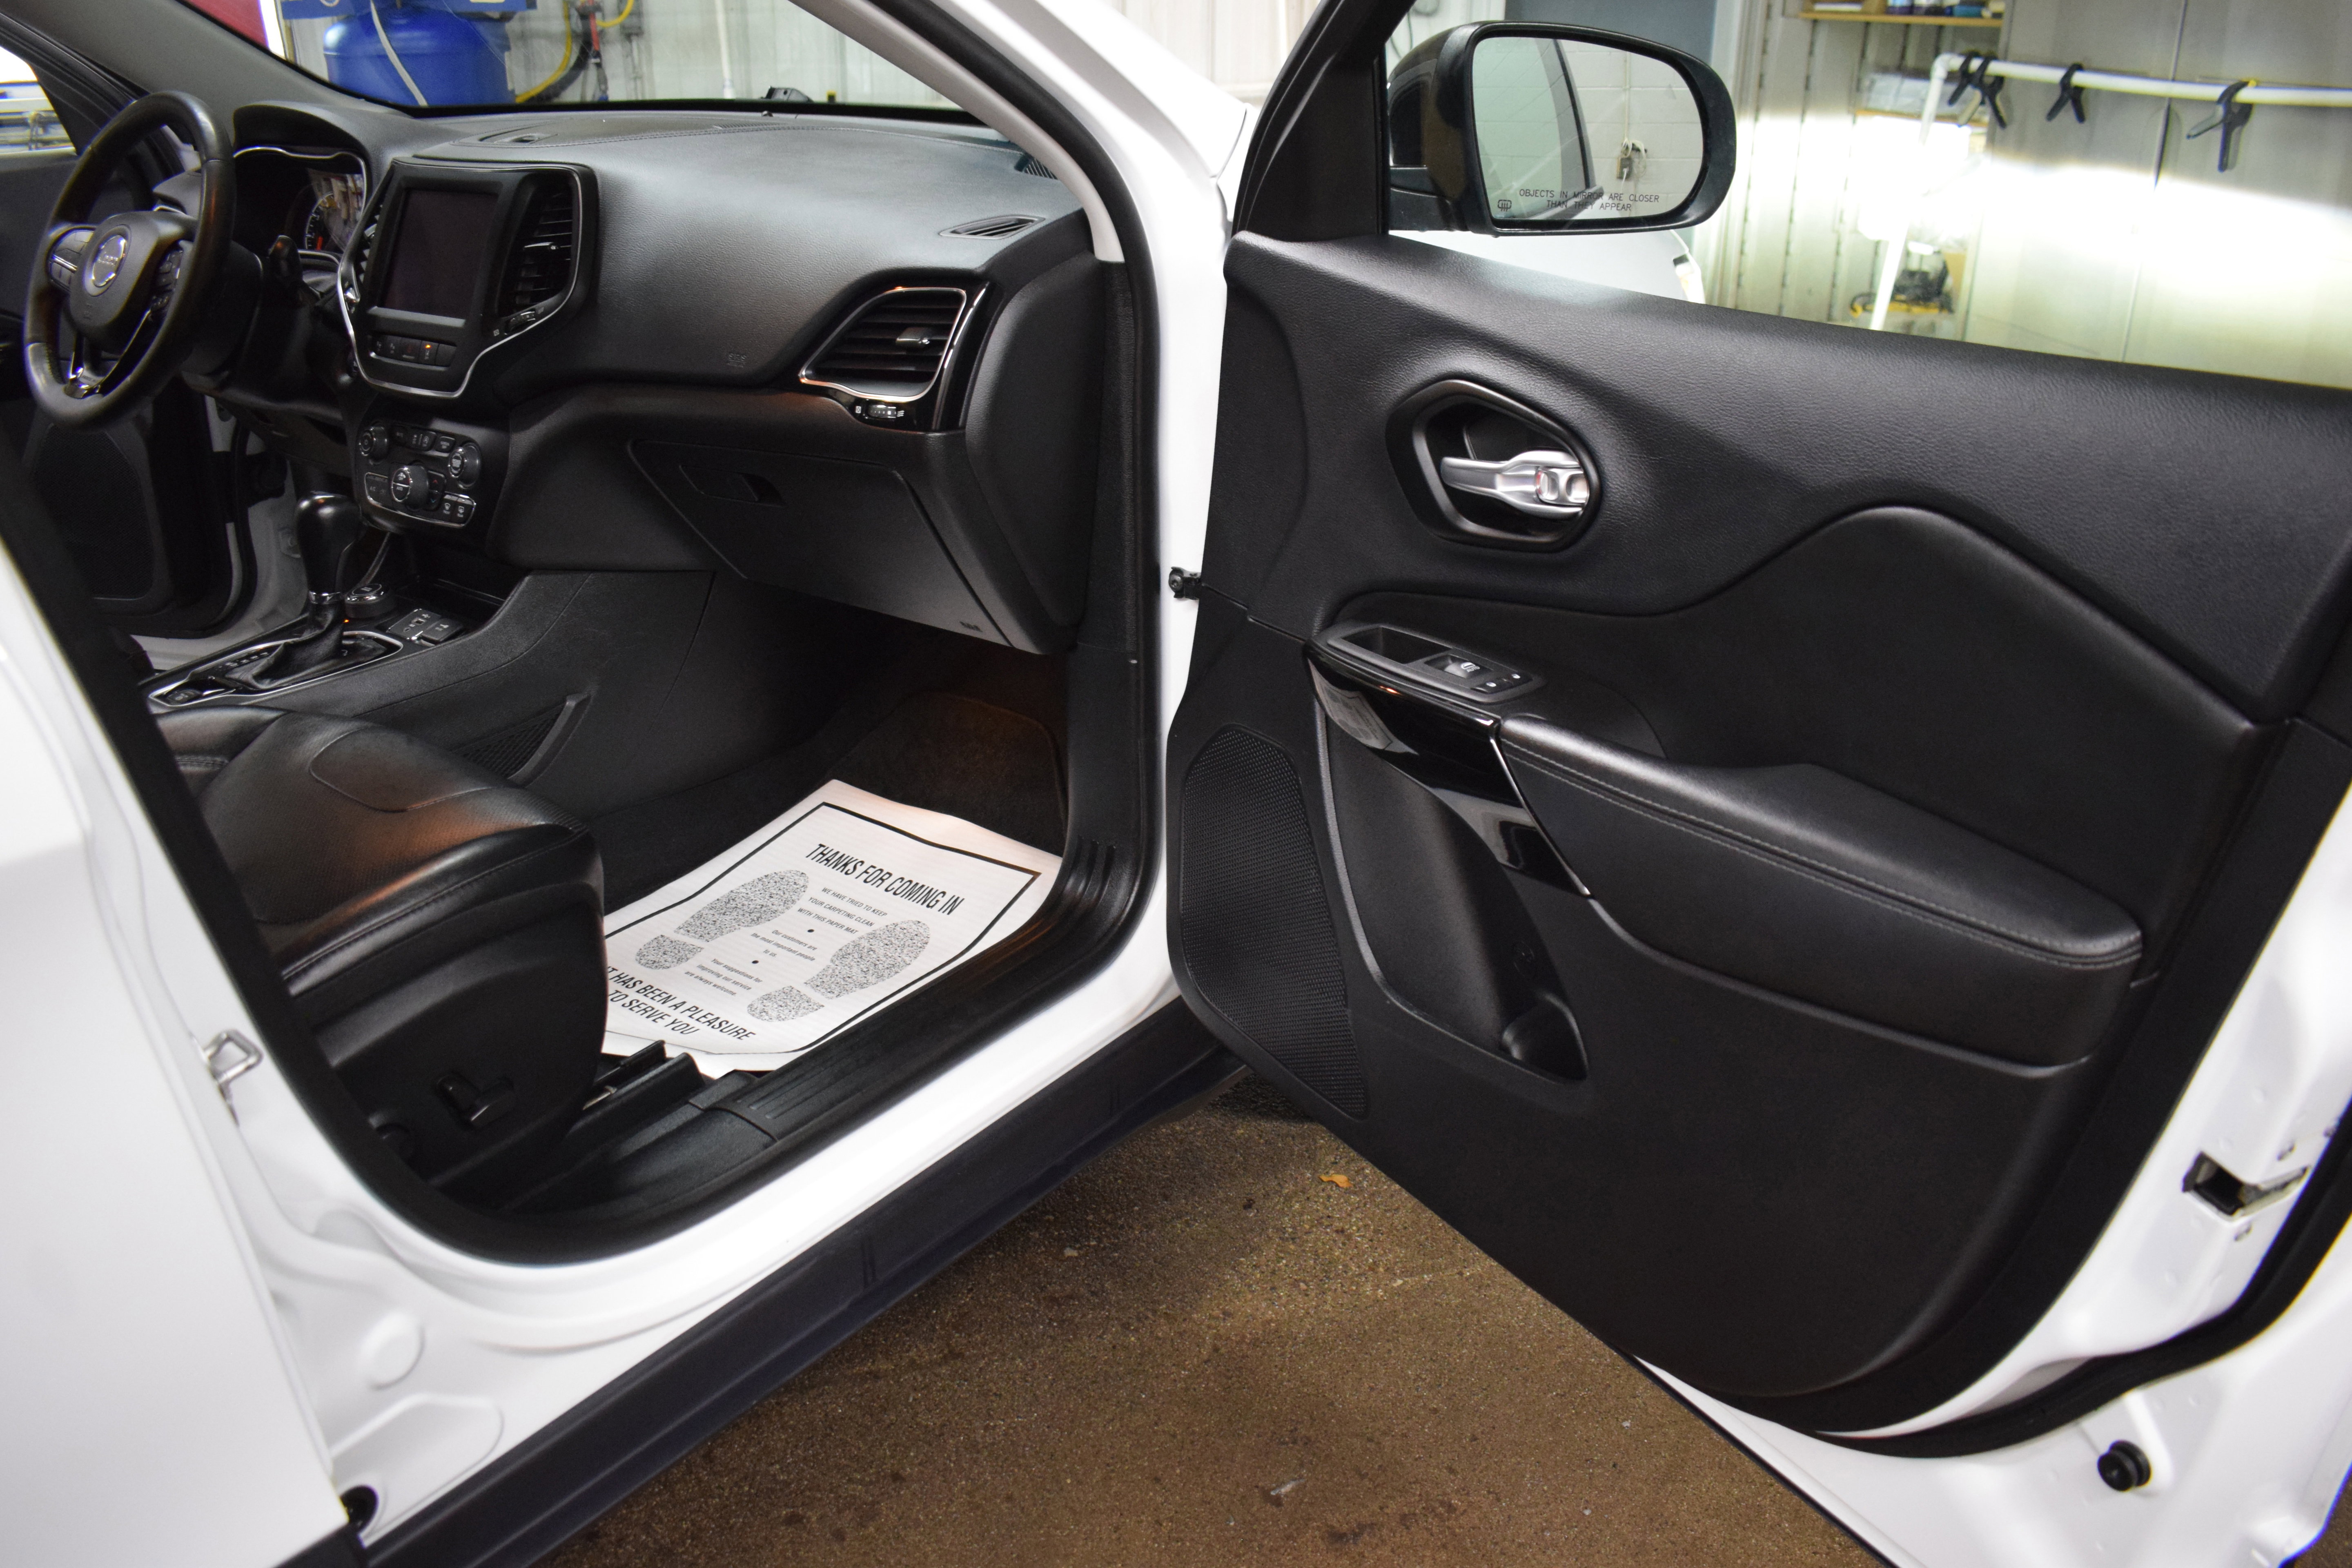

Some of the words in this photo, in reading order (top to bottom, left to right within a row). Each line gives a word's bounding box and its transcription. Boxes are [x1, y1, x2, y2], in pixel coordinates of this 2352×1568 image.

[1519, 188, 1555, 198] OBJECTS
[1573, 191, 1604, 200] MIRROR
[1629, 194, 1659, 203] CLOSER
[1546, 200, 1568, 209] THAN
[1574, 201, 1593, 210] THEY
[1599, 202, 1632, 211] APPEAR
[805, 843, 865, 875] THANKS
[855, 865, 893, 888] FOR
[884, 877, 947, 909] COMING
[938, 895, 965, 915] IN
[808, 897, 825, 906] YOUR
[824, 904, 855, 920] CARPETING
[854, 916, 875, 927] CLEAN
[831, 891, 848, 901] HAVE
[846, 898, 865, 908] TRIED
[871, 907, 888, 917] KEEP
[797, 907, 813, 917] WITH
[813, 913, 827, 922] THIS
[826, 919, 845, 930] PAPER
[844, 927, 859, 935] MAT
[759, 936, 774, 945] most
[773, 941, 799, 956] important
[796, 951, 816, 962] people
[781, 934, 808, 948] customers
[697, 964, 723, 978] improving
[731, 980, 752, 991] service
[722, 964, 754, 980] suggestions
[693, 974, 713, 986] always
[712, 982, 737, 997] welcome.
[608, 989, 629, 1002] TO
[621, 998, 671, 1024] SERVE
[664, 1018, 700, 1035] YOU
[609, 972, 643, 989] HAS
[635, 984, 677, 1005] BEEN
[668, 1000, 687, 1011] A
[679, 1005, 757, 1041] PLEASURE
